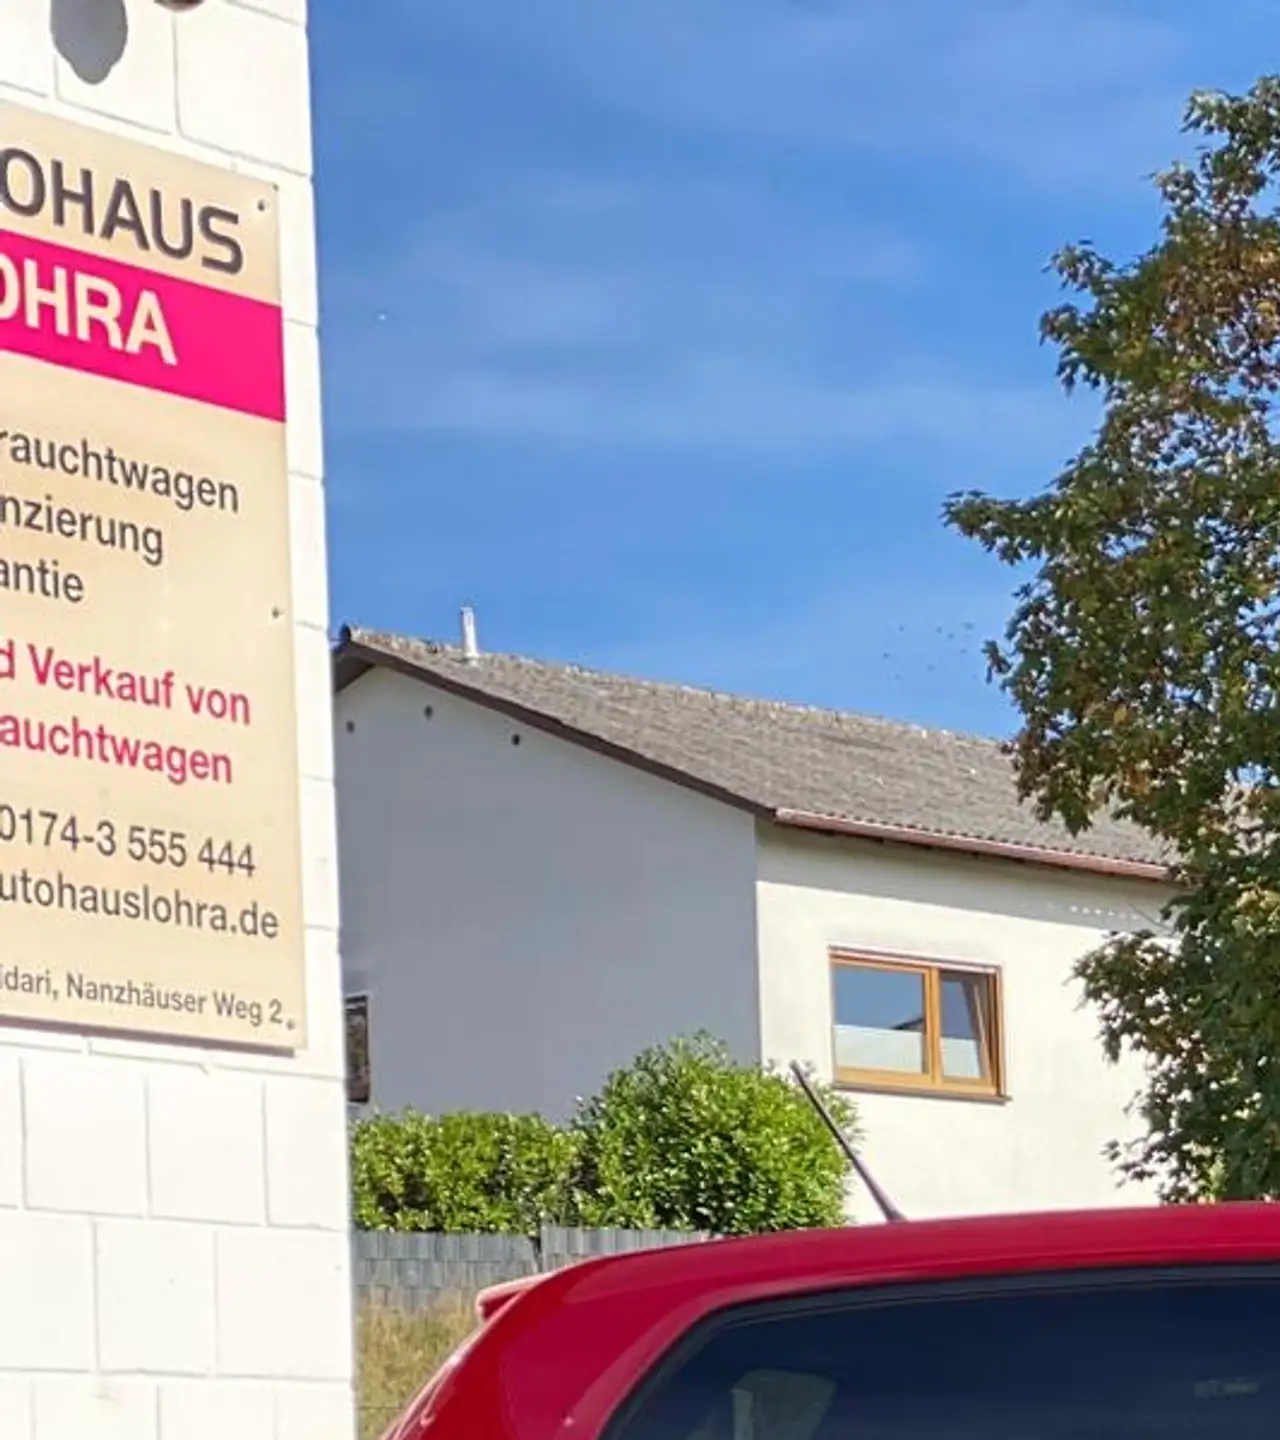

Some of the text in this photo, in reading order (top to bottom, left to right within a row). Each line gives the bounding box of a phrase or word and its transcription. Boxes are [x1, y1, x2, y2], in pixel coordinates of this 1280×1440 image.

[0, 147, 244, 275] OHAUS
[0, 429, 239, 513] auchtwagen
[0, 493, 164, 567] nzierung
[27, 643, 175, 708] Verkauf
[186, 681, 251, 726] von
[0, 714, 234, 786] auchtwagen
[0, 804, 257, 878] 0174-3 555 444
[0, 868, 279, 940] utohauslohra.de
[66, 971, 206, 1014] Nanzhäuser
[211, 989, 262, 1028] Weg
